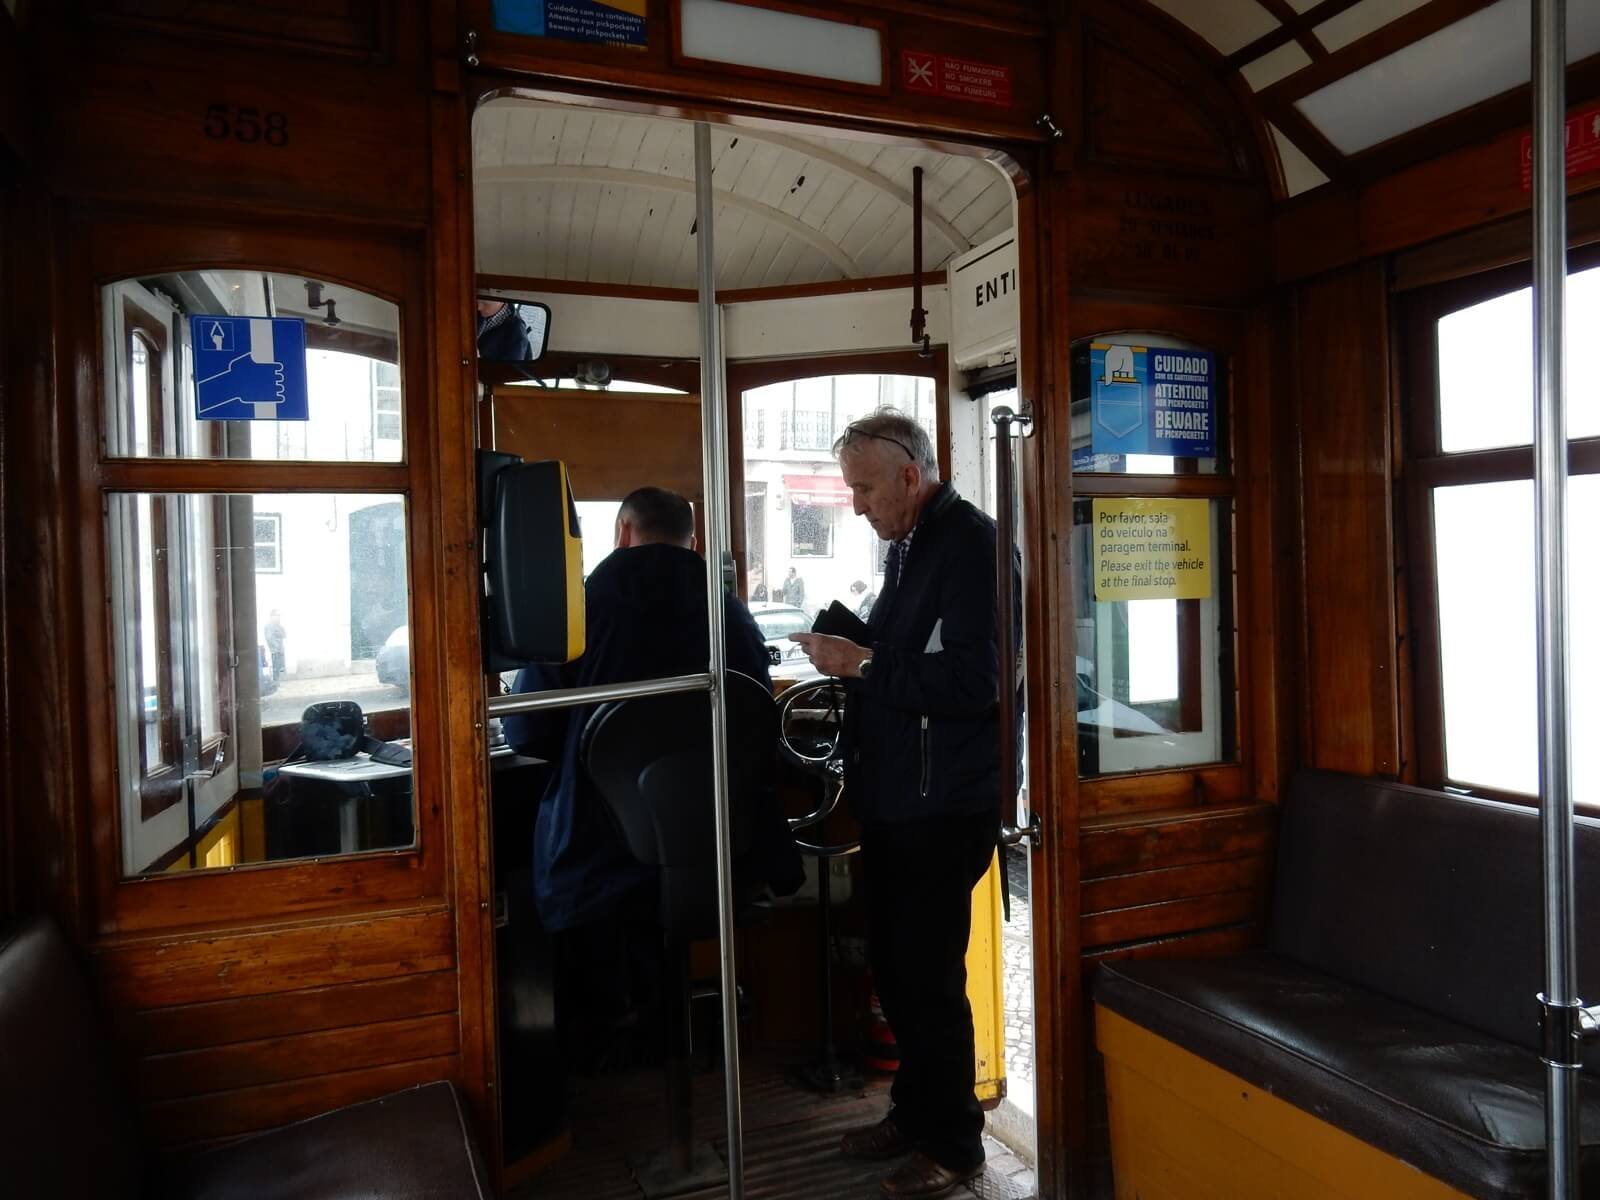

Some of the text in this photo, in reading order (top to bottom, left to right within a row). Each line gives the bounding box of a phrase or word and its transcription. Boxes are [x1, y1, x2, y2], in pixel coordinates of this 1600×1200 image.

[548, 2, 578, 14] Cuidado
[549, 12, 580, 23] Attention
[596, 20, 635, 32] pickpockets
[549, 21, 575, 32] Beware
[586, 28, 625, 40] pickpockets
[963, 64, 1005, 78] FUMADORES
[945, 72, 992, 86] NO SMOKERS
[946, 84, 997, 99] NON FUMEURS
[204, 103, 289, 147] 558
[1154, 354, 1208, 375] CUIDADO
[1155, 383, 1208, 401] ATTENTION
[1168, 399, 1205, 410] PICKPOCKETS
[1156, 410, 1208, 431] BEWARE
[1156, 430, 1164, 438] OF
[1165, 430, 1205, 440] PICKPOCKETS
[1100, 511, 1169, 525] Por favor, saia
[1100, 527, 1114, 538] do
[1156, 528, 1168, 538] na
[1100, 540, 1191, 557] paragem terminal.
[1101, 558, 1205, 572] Please exit the vehicle
[1101, 575, 1177, 590] at the final stop.
